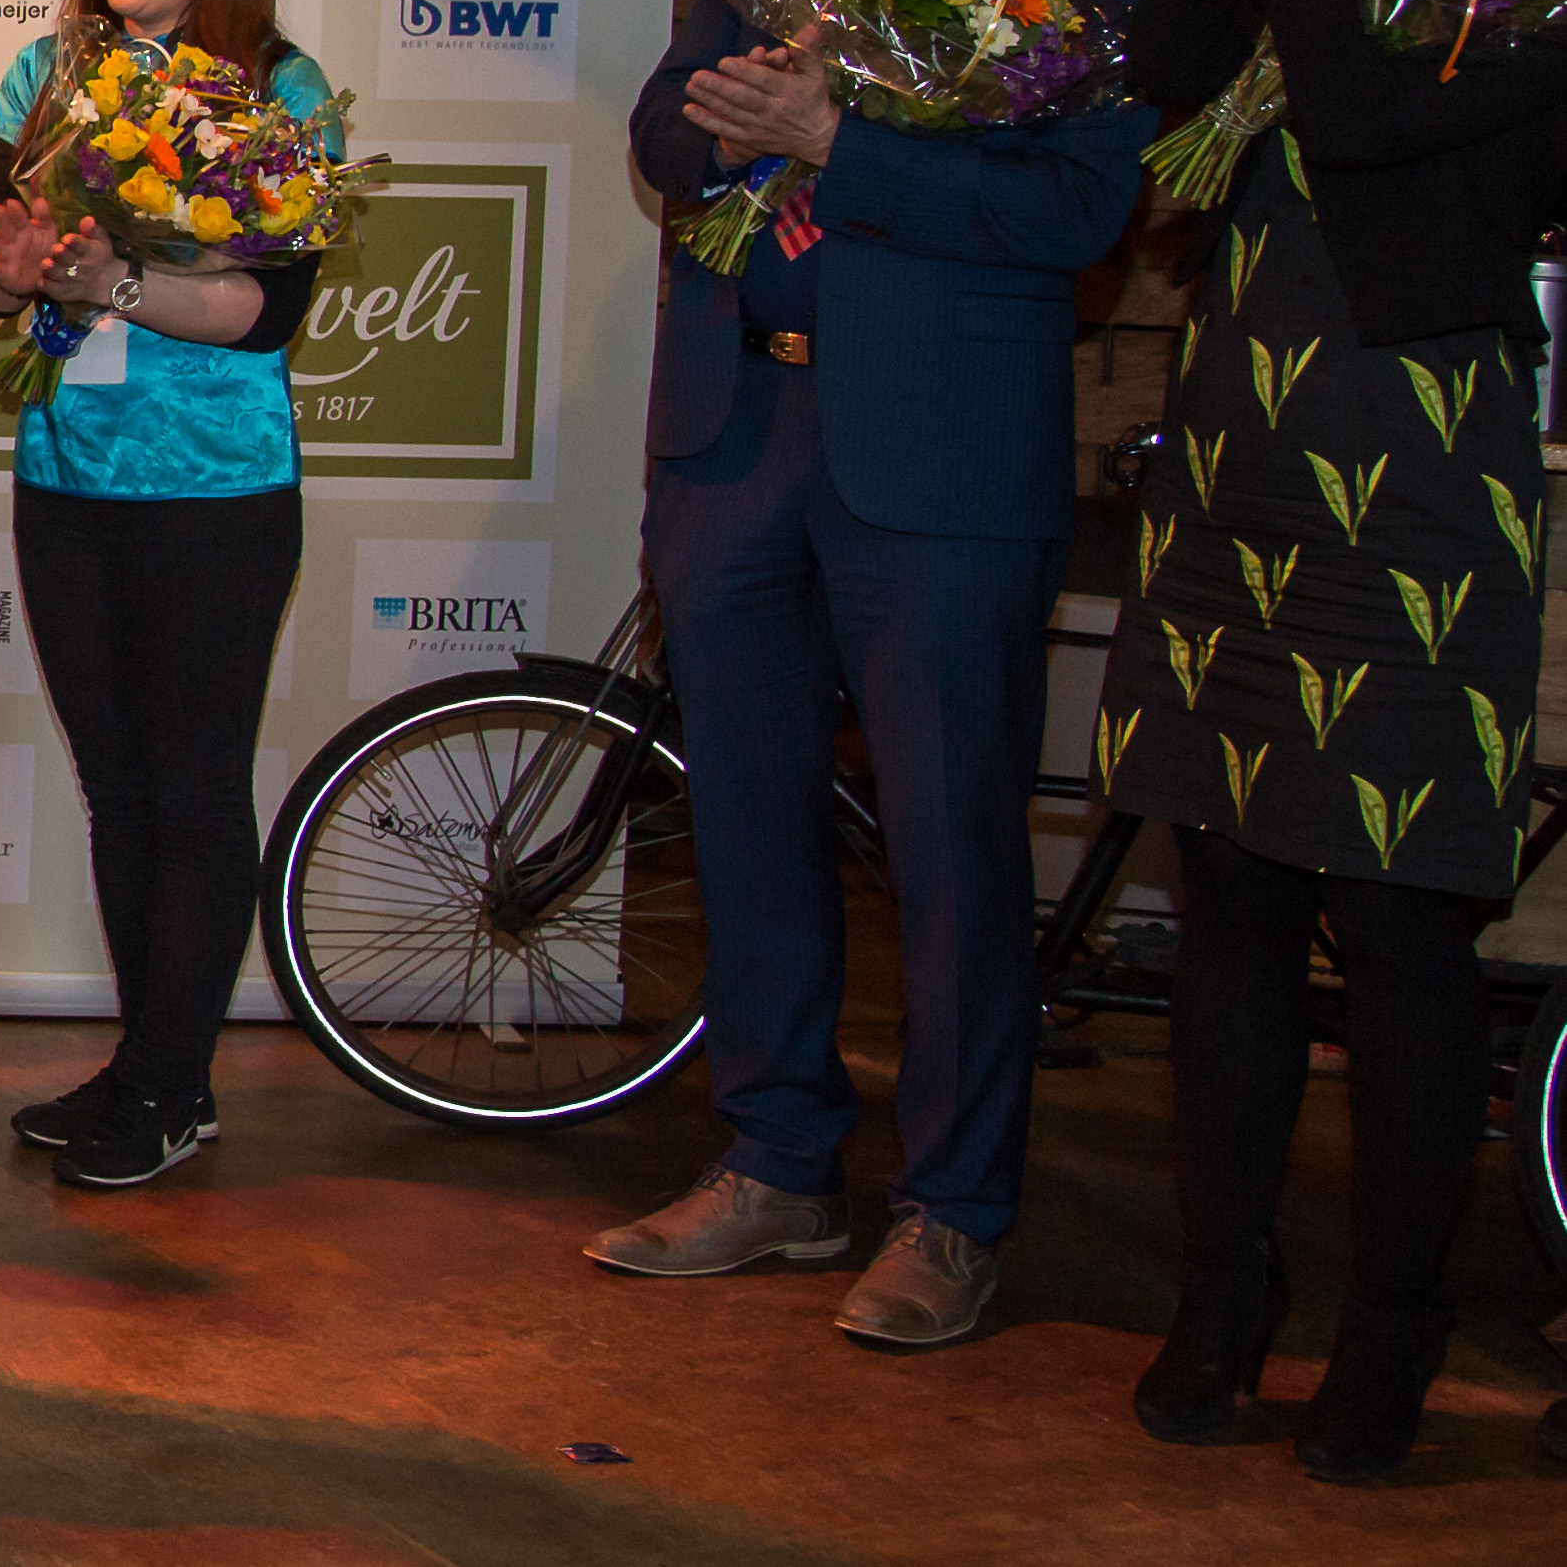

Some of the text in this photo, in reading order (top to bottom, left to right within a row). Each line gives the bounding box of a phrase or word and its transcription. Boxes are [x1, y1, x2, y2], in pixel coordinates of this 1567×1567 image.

[449, 0, 560, 38] BWT
[401, 41, 555, 51] BEST WATER TECHNOLOGY
[306, 244, 481, 343] velt
[316, 395, 375, 421] 1817
[408, 597, 528, 632] BRITA
[408, 638, 526, 654] Professional
